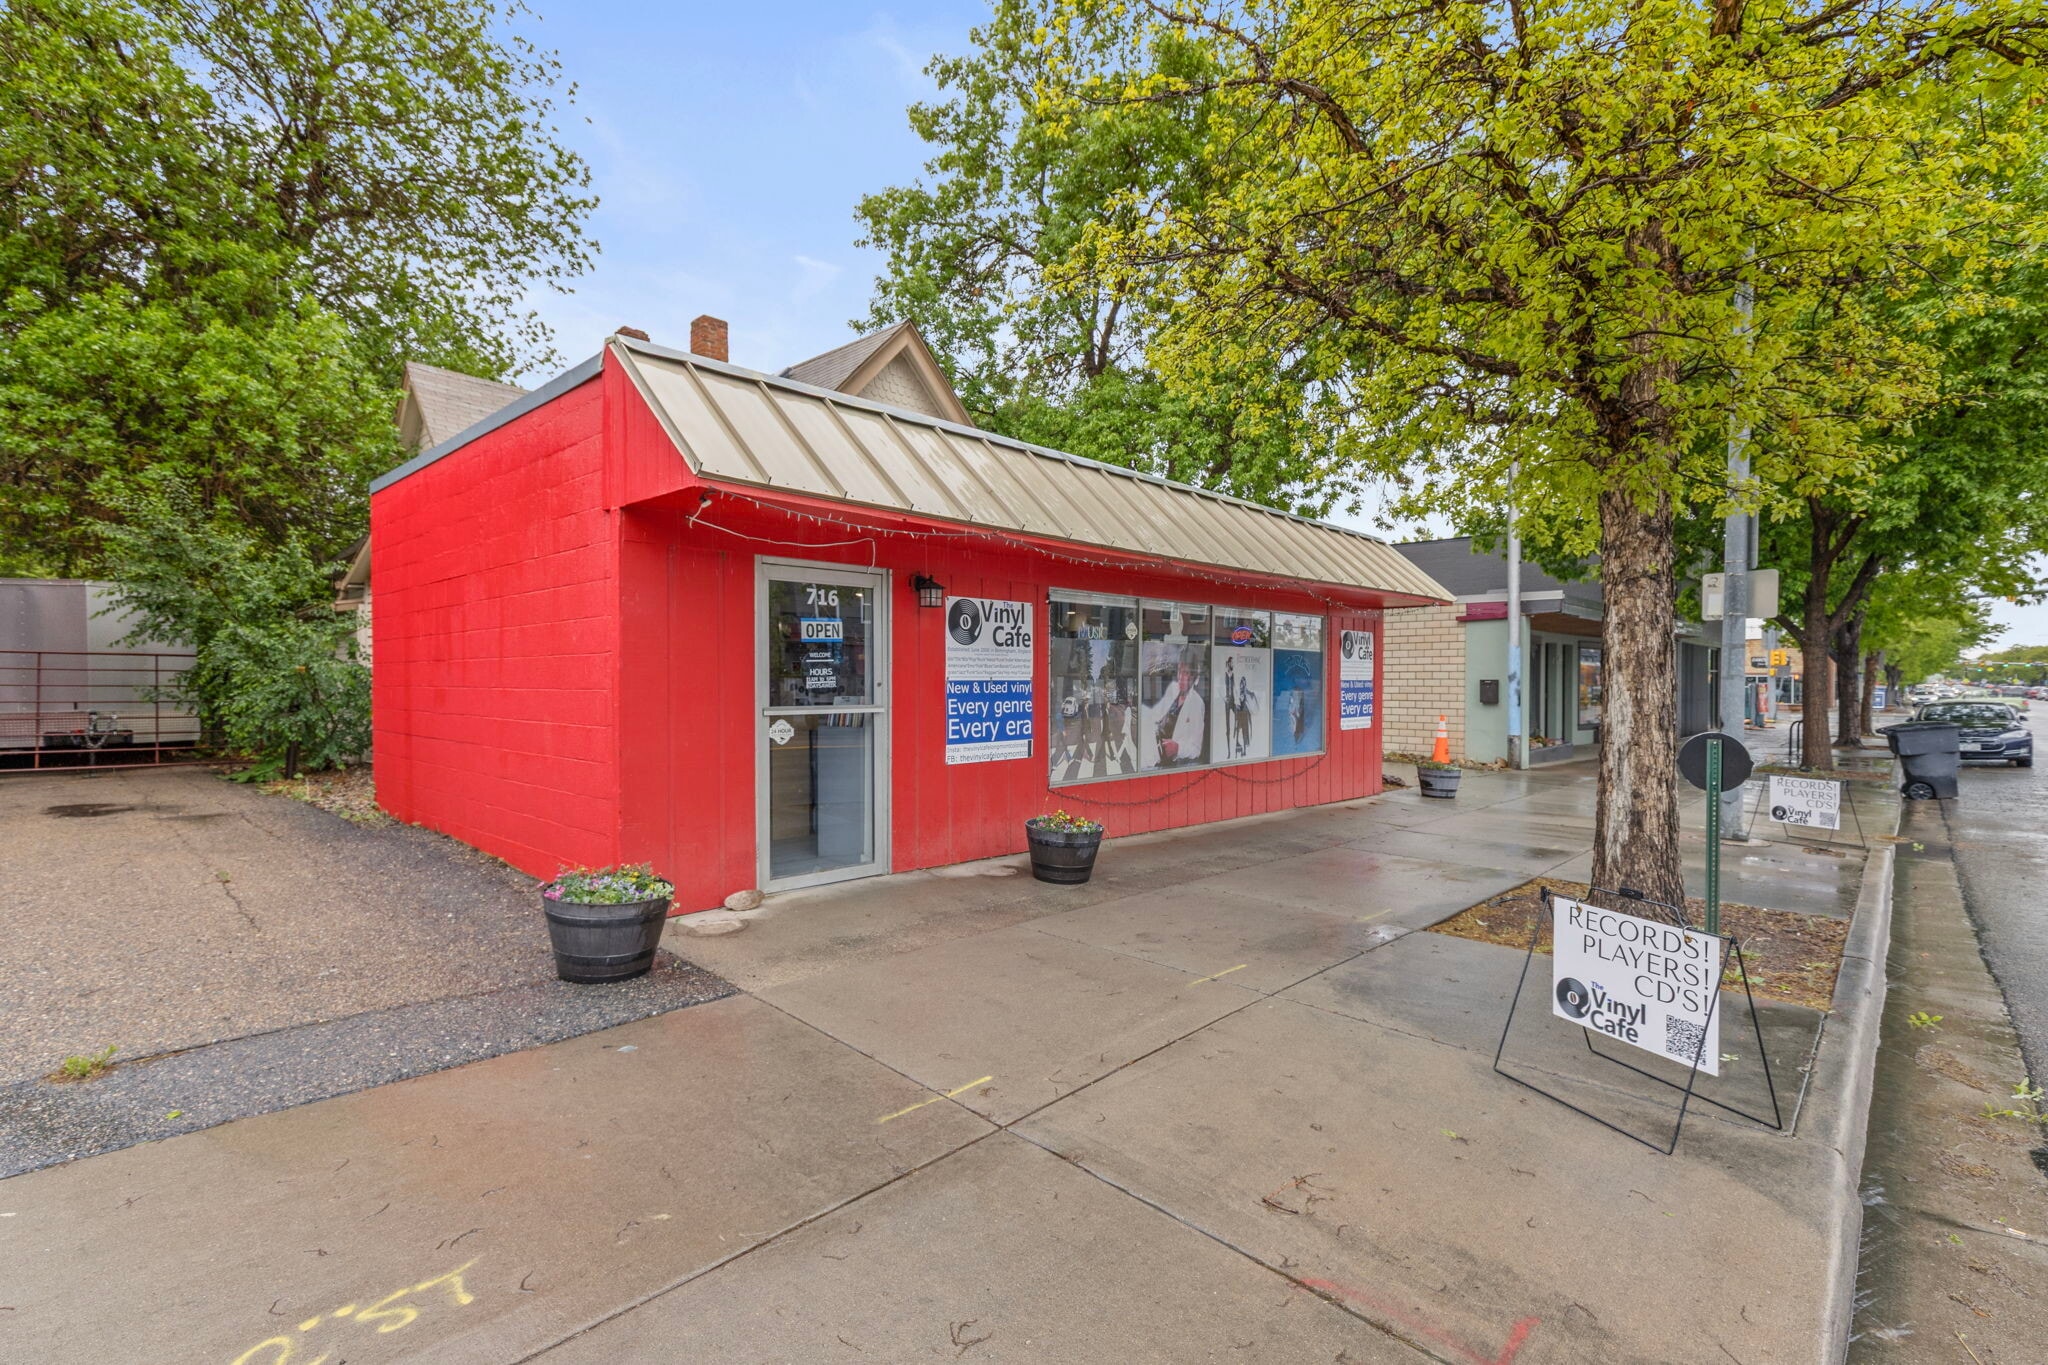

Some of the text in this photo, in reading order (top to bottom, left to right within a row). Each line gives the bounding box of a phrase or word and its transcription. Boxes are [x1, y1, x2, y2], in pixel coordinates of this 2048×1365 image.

[806, 587, 839, 606] 716
[980, 600, 1025, 629] Vinyl
[806, 623, 840, 638] OPEN
[992, 625, 1031, 648] Cafe
[1232, 629, 1251, 641] OPEN
[1353, 631, 1371, 646] Vinyl
[1358, 646, 1372, 660] Cafe
[810, 667, 833, 676] HOURS
[947, 682, 1032, 694] New & Used vinyl
[1341, 690, 1373, 702] Every genre
[948, 698, 1032, 718] Every genre
[1341, 702, 1373, 717] Every era
[948, 718, 1032, 741] Every era
[1776, 778, 1837, 791] RECORDS!
[1783, 788, 1837, 801] PLAYERS!
[1787, 815, 1809, 824] Cafe
[1788, 807, 1812, 819] Vinyl
[1569, 906, 1709, 963] RECORDS!
[1583, 934, 1709, 990] PLAYERS!
[1591, 981, 1604, 990] The
[1634, 975, 1708, 1016] CD'S!
[1591, 987, 1646, 1026] Vinyl
[1590, 1009, 1639, 1043] Cafe
